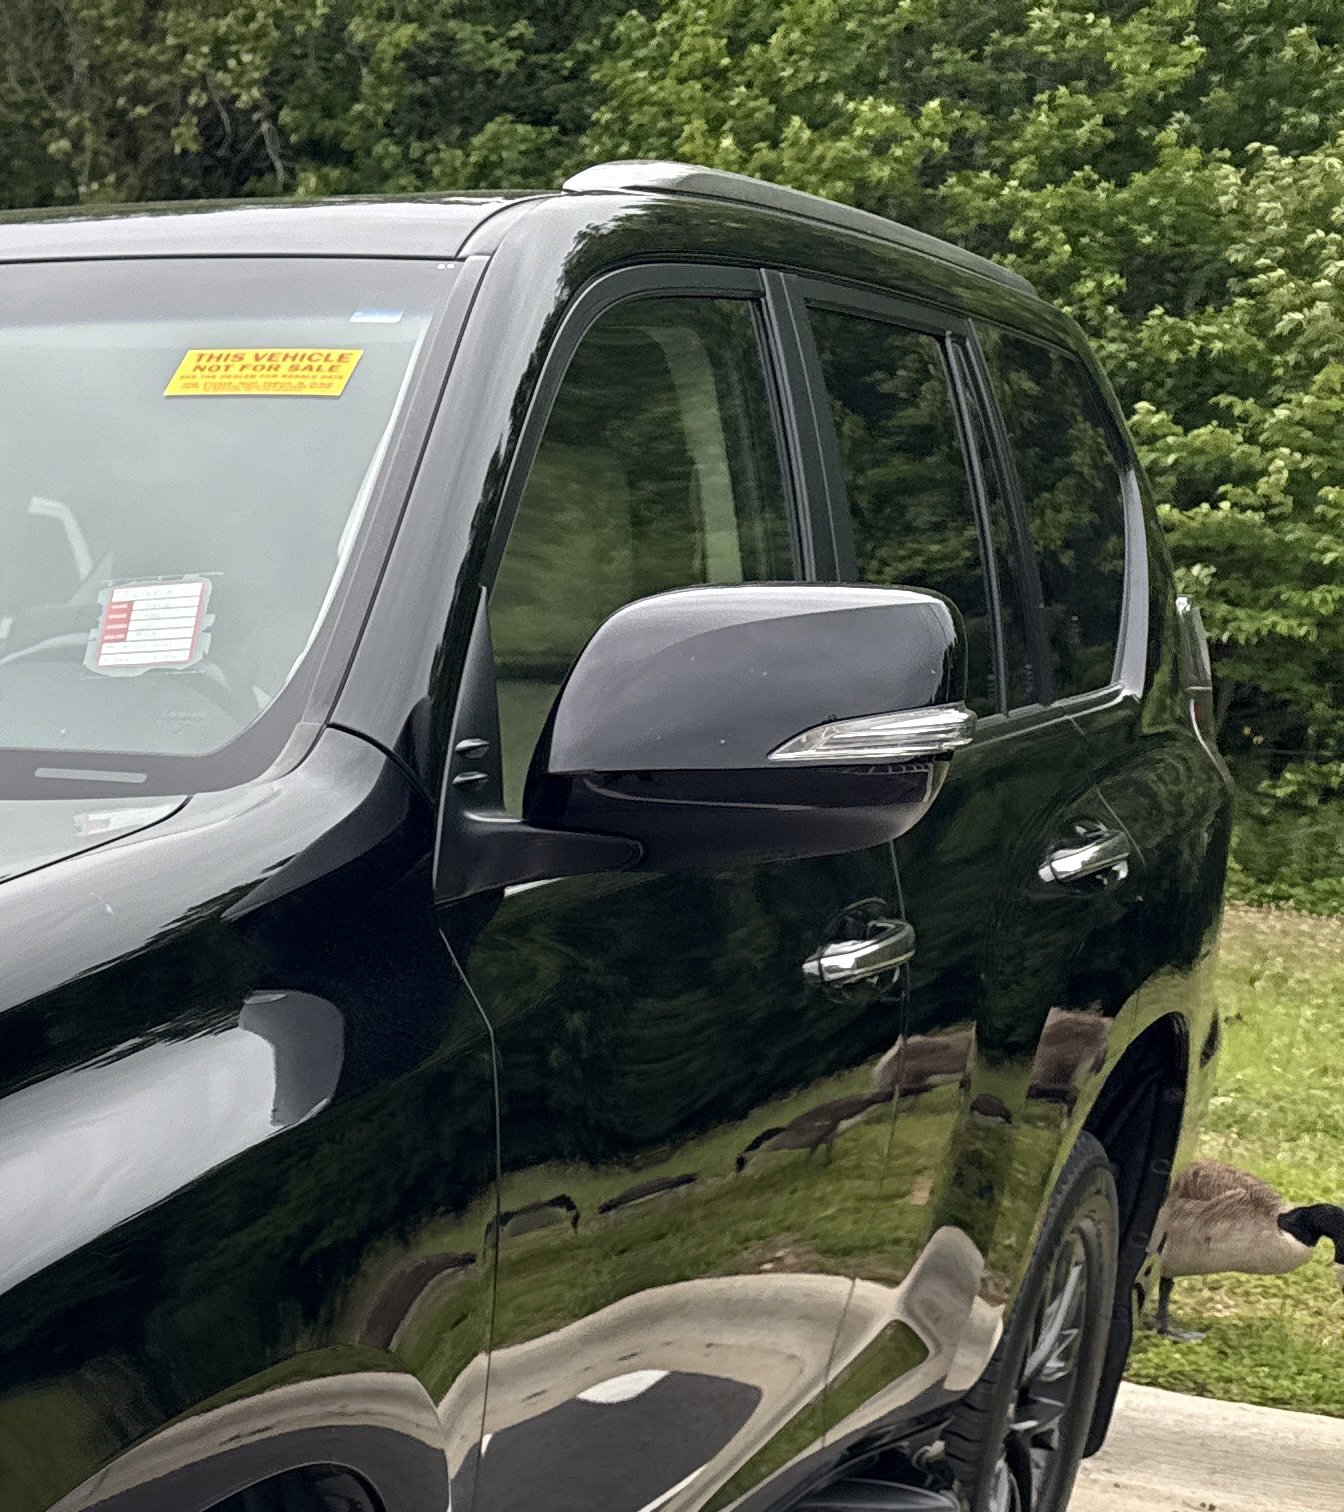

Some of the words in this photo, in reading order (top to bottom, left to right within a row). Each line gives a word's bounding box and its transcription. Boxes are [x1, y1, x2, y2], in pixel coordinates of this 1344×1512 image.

[194, 352, 245, 363] THIS
[254, 352, 354, 363] VEHICLE
[192, 364, 231, 373] NOT
[239, 364, 281, 373] FOR
[287, 364, 343, 373] SALE
